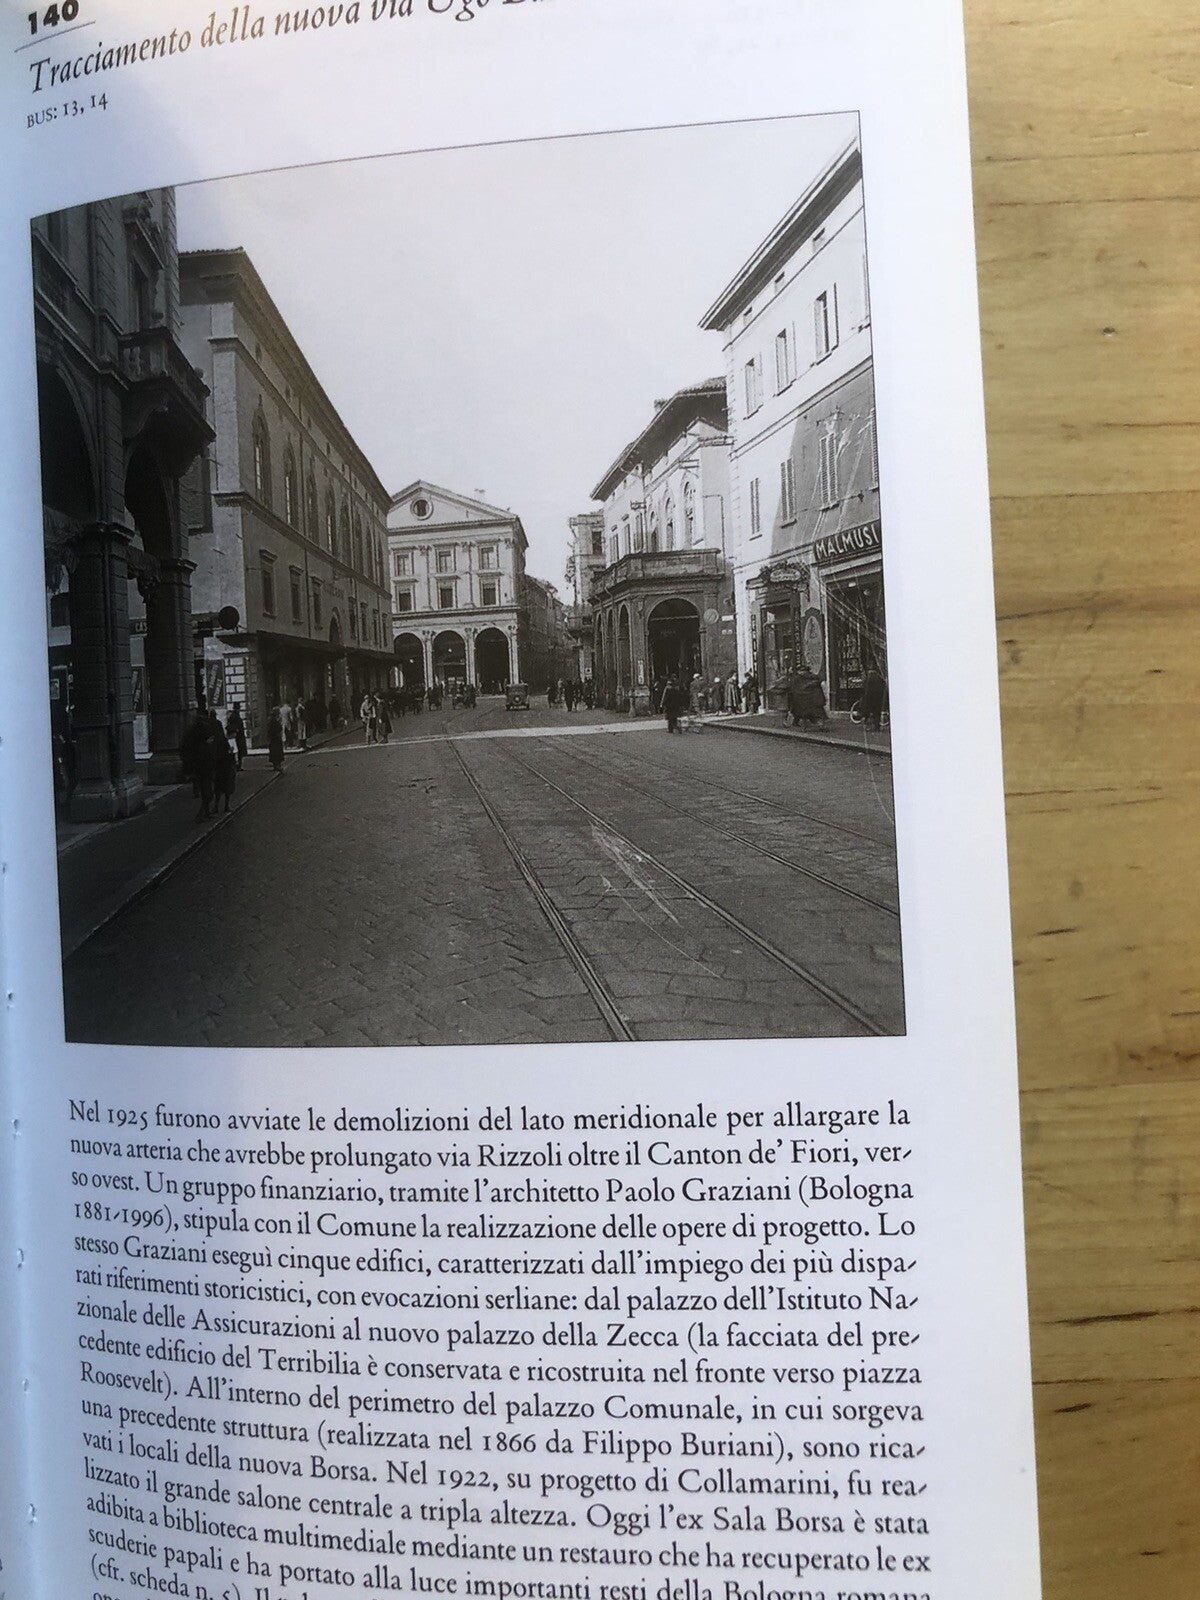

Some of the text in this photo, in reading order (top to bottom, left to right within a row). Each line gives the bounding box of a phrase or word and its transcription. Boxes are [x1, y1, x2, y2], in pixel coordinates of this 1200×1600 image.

[28, 0, 79, 35] 140
[29, 28, 192, 93] Tracciamento
[200, 4, 265, 48] della
[274, 1, 361, 36] nuova
[27, 92, 109, 129] BUS: 13, 14
[815, 523, 880, 560] MALMUSI
[68, 1098, 880, 1137] Nel 1925 furono avviate demolizioni del lato meridionale per allargare
[70, 1137, 859, 1175] nuova arteria che avrebbe prolungato via Rizzoli oltre Canton de' Fiori,
[71, 1170, 915, 1209] so ovest. Un gruppo finanziario, tramite l'architetto Paolo Graziani (Bologna
[183, 1206, 251, 1238] stipula
[253, 1217, 293, 1234] con
[316, 1212, 417, 1238] Comune
[446, 1213, 597, 1239] realizzazione
[601, 1212, 658, 1239] delle
[662, 1221, 727, 1247] opere
[762, 1218, 870, 1246] progetto.
[877, 1211, 916, 1237] Lo
[74, 1235, 834, 1283] stesso Graziani eseguì cinque edifici, caratterizzati dall'impiego dei più
[75, 1263, 863, 1319] rati riferimenti storicistici, con evocazioni serliane: dal palazzo dell'Istituto
[76, 1294, 864, 1355] zionale delle Assicurazioni nuovo palazzo della Zecca (la facciata del
[78, 1329, 923, 1393] cedente edificio del Terribilia conservata ricostruita nel fronte verso piazza
[80, 1360, 925, 1430] Roosevelt). All'interno del perimetro del palazzo Comunale, in cui sorgeva
[81, 1399, 861, 1466] una precedente struttura (realizzata nel 1866 da Filippo Buriani), sono
[82, 1429, 873, 1500] vati locali della nuova Borsa. Nel 1922, su progetto Collamarini, fu
[83, 1455, 930, 1537] lizzato grande salone centrale tripla altezza. Oggi l'ex Sala Borsa stata
[86, 1491, 932, 1579] adibita biblioteca multimediale mediante un restauro che ha recuperato ex
[88, 1528, 158, 1559] scuderie
[163, 1545, 224, 1574] papali
[246, 1551, 273, 1578] ha
[278, 1563, 356, 1588] portato
[362, 1563, 403, 1591] alla
[409, 1566, 458, 1595] luce
[465, 1570, 591, 1600] importanti
[599, 1577, 647, 1600] resti
[656, 1576, 713, 1600] della
[91, 1552, 125, 1582] (cfr.
[129, 1566, 191, 1600] scheda
